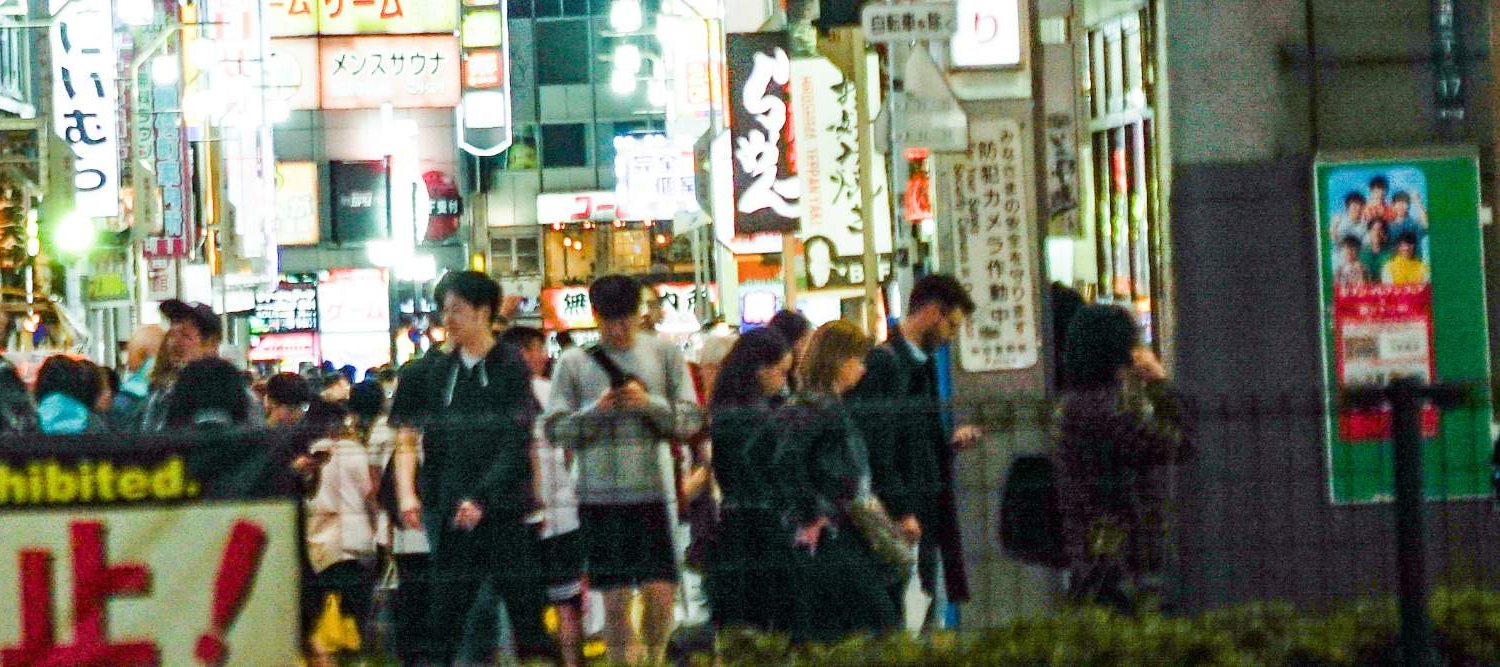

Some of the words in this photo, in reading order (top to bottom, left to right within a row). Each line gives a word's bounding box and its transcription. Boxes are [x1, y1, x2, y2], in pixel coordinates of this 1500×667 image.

[973, 12, 998, 44] り
[332, 51, 445, 77] メンスサウナ
[978, 140, 1010, 322] 防犯カメラ作動中
